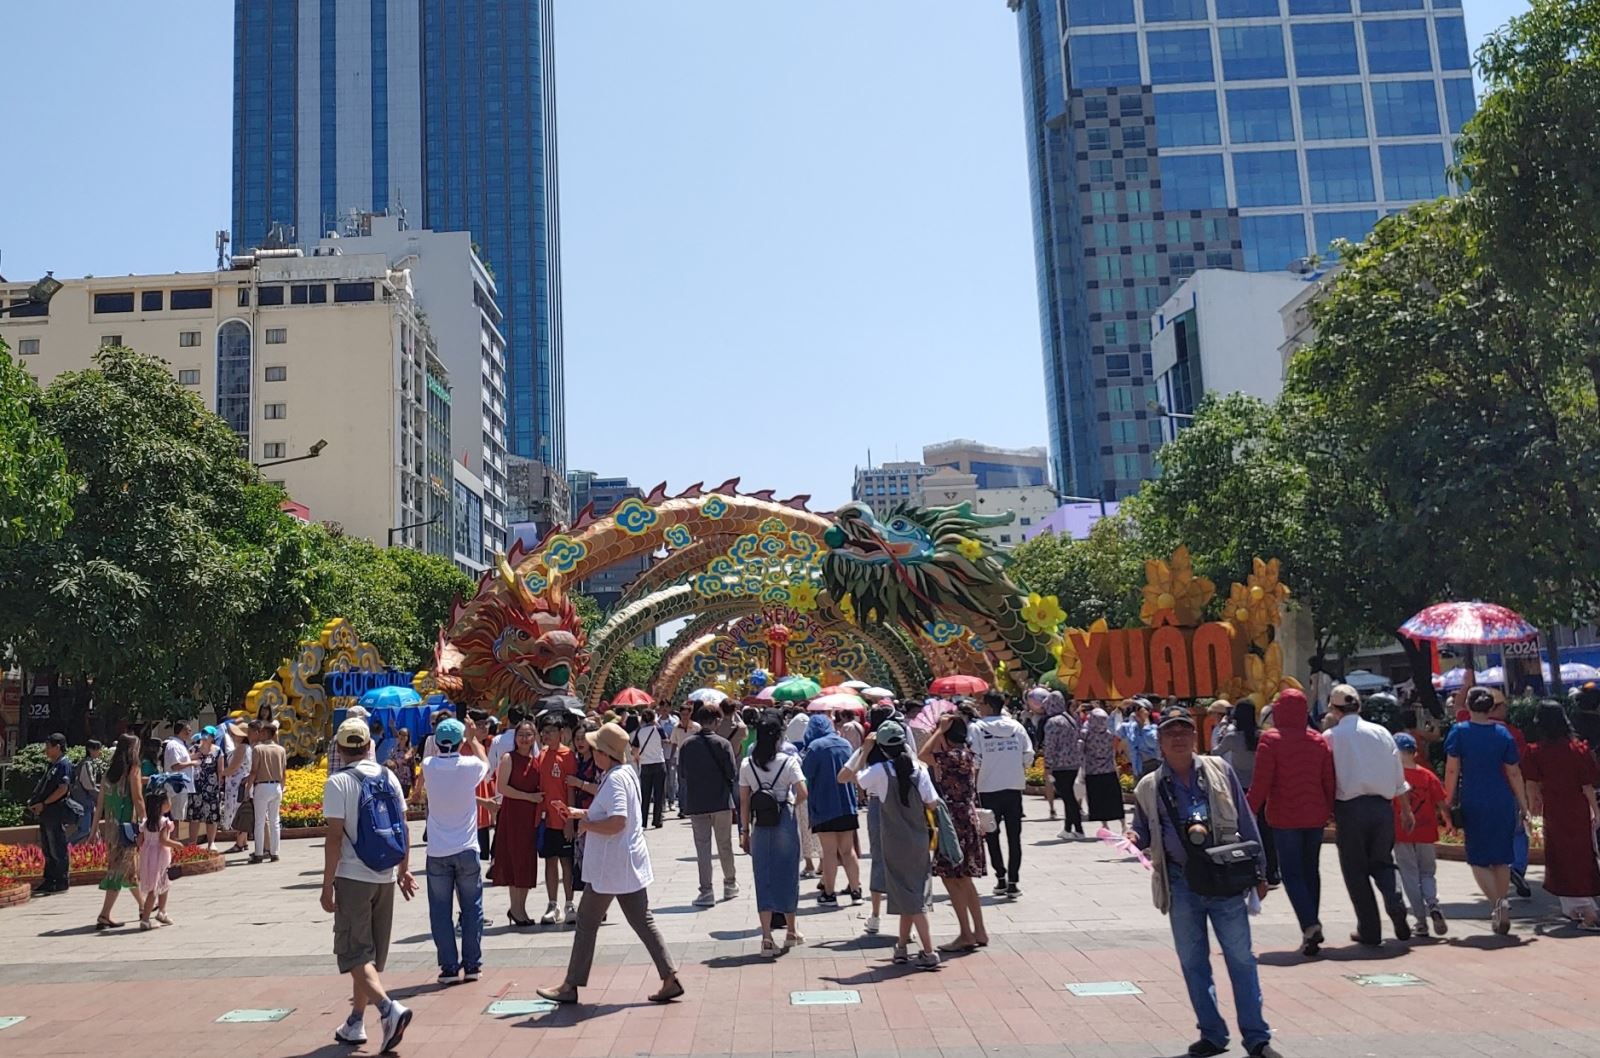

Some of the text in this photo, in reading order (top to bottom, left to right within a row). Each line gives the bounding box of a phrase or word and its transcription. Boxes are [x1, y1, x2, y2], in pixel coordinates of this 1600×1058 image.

[717, 607, 839, 660] HAPPY NEW YEAR
[1505, 641, 1538, 654] 2024
